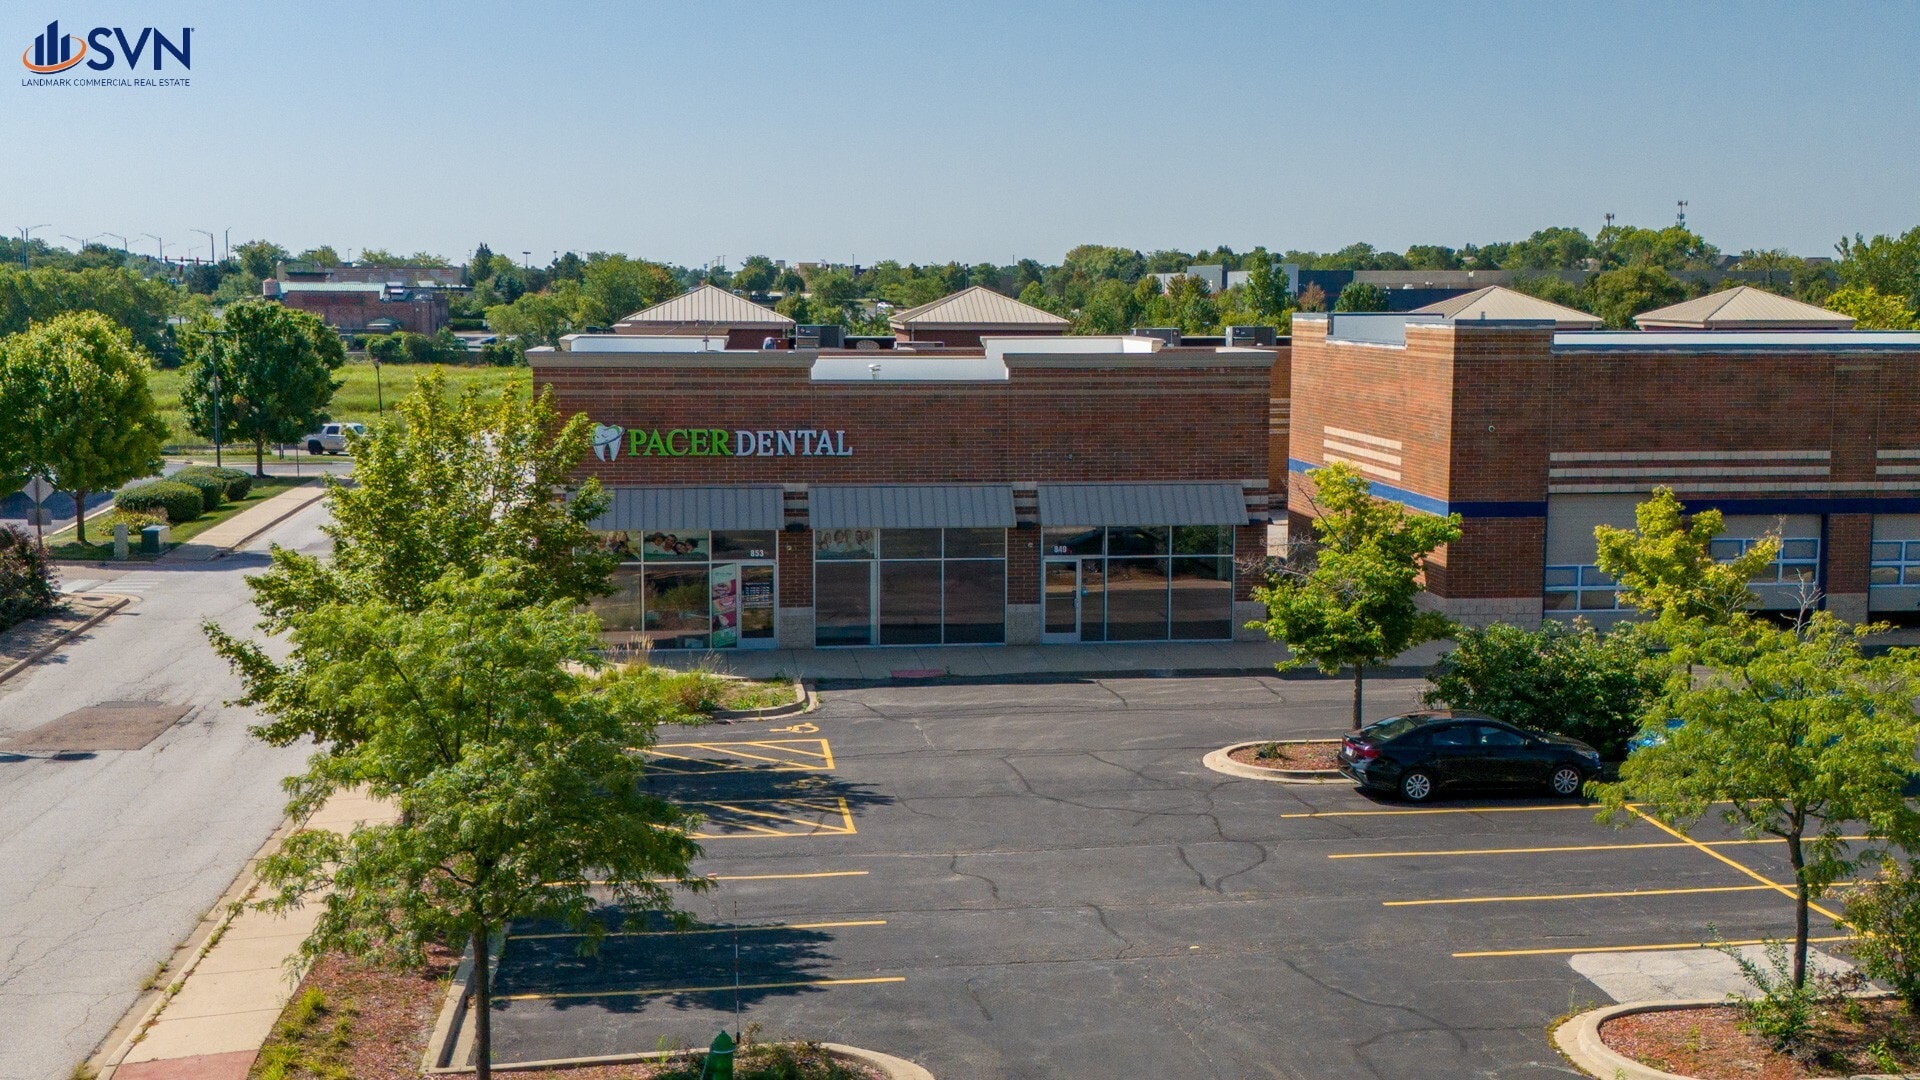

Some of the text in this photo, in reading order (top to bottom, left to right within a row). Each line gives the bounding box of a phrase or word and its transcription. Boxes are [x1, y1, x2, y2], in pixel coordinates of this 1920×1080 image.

[627, 428, 854, 457] PACER DENTAL
[750, 549, 764, 557] 853
[1053, 545, 1068, 553] 849
